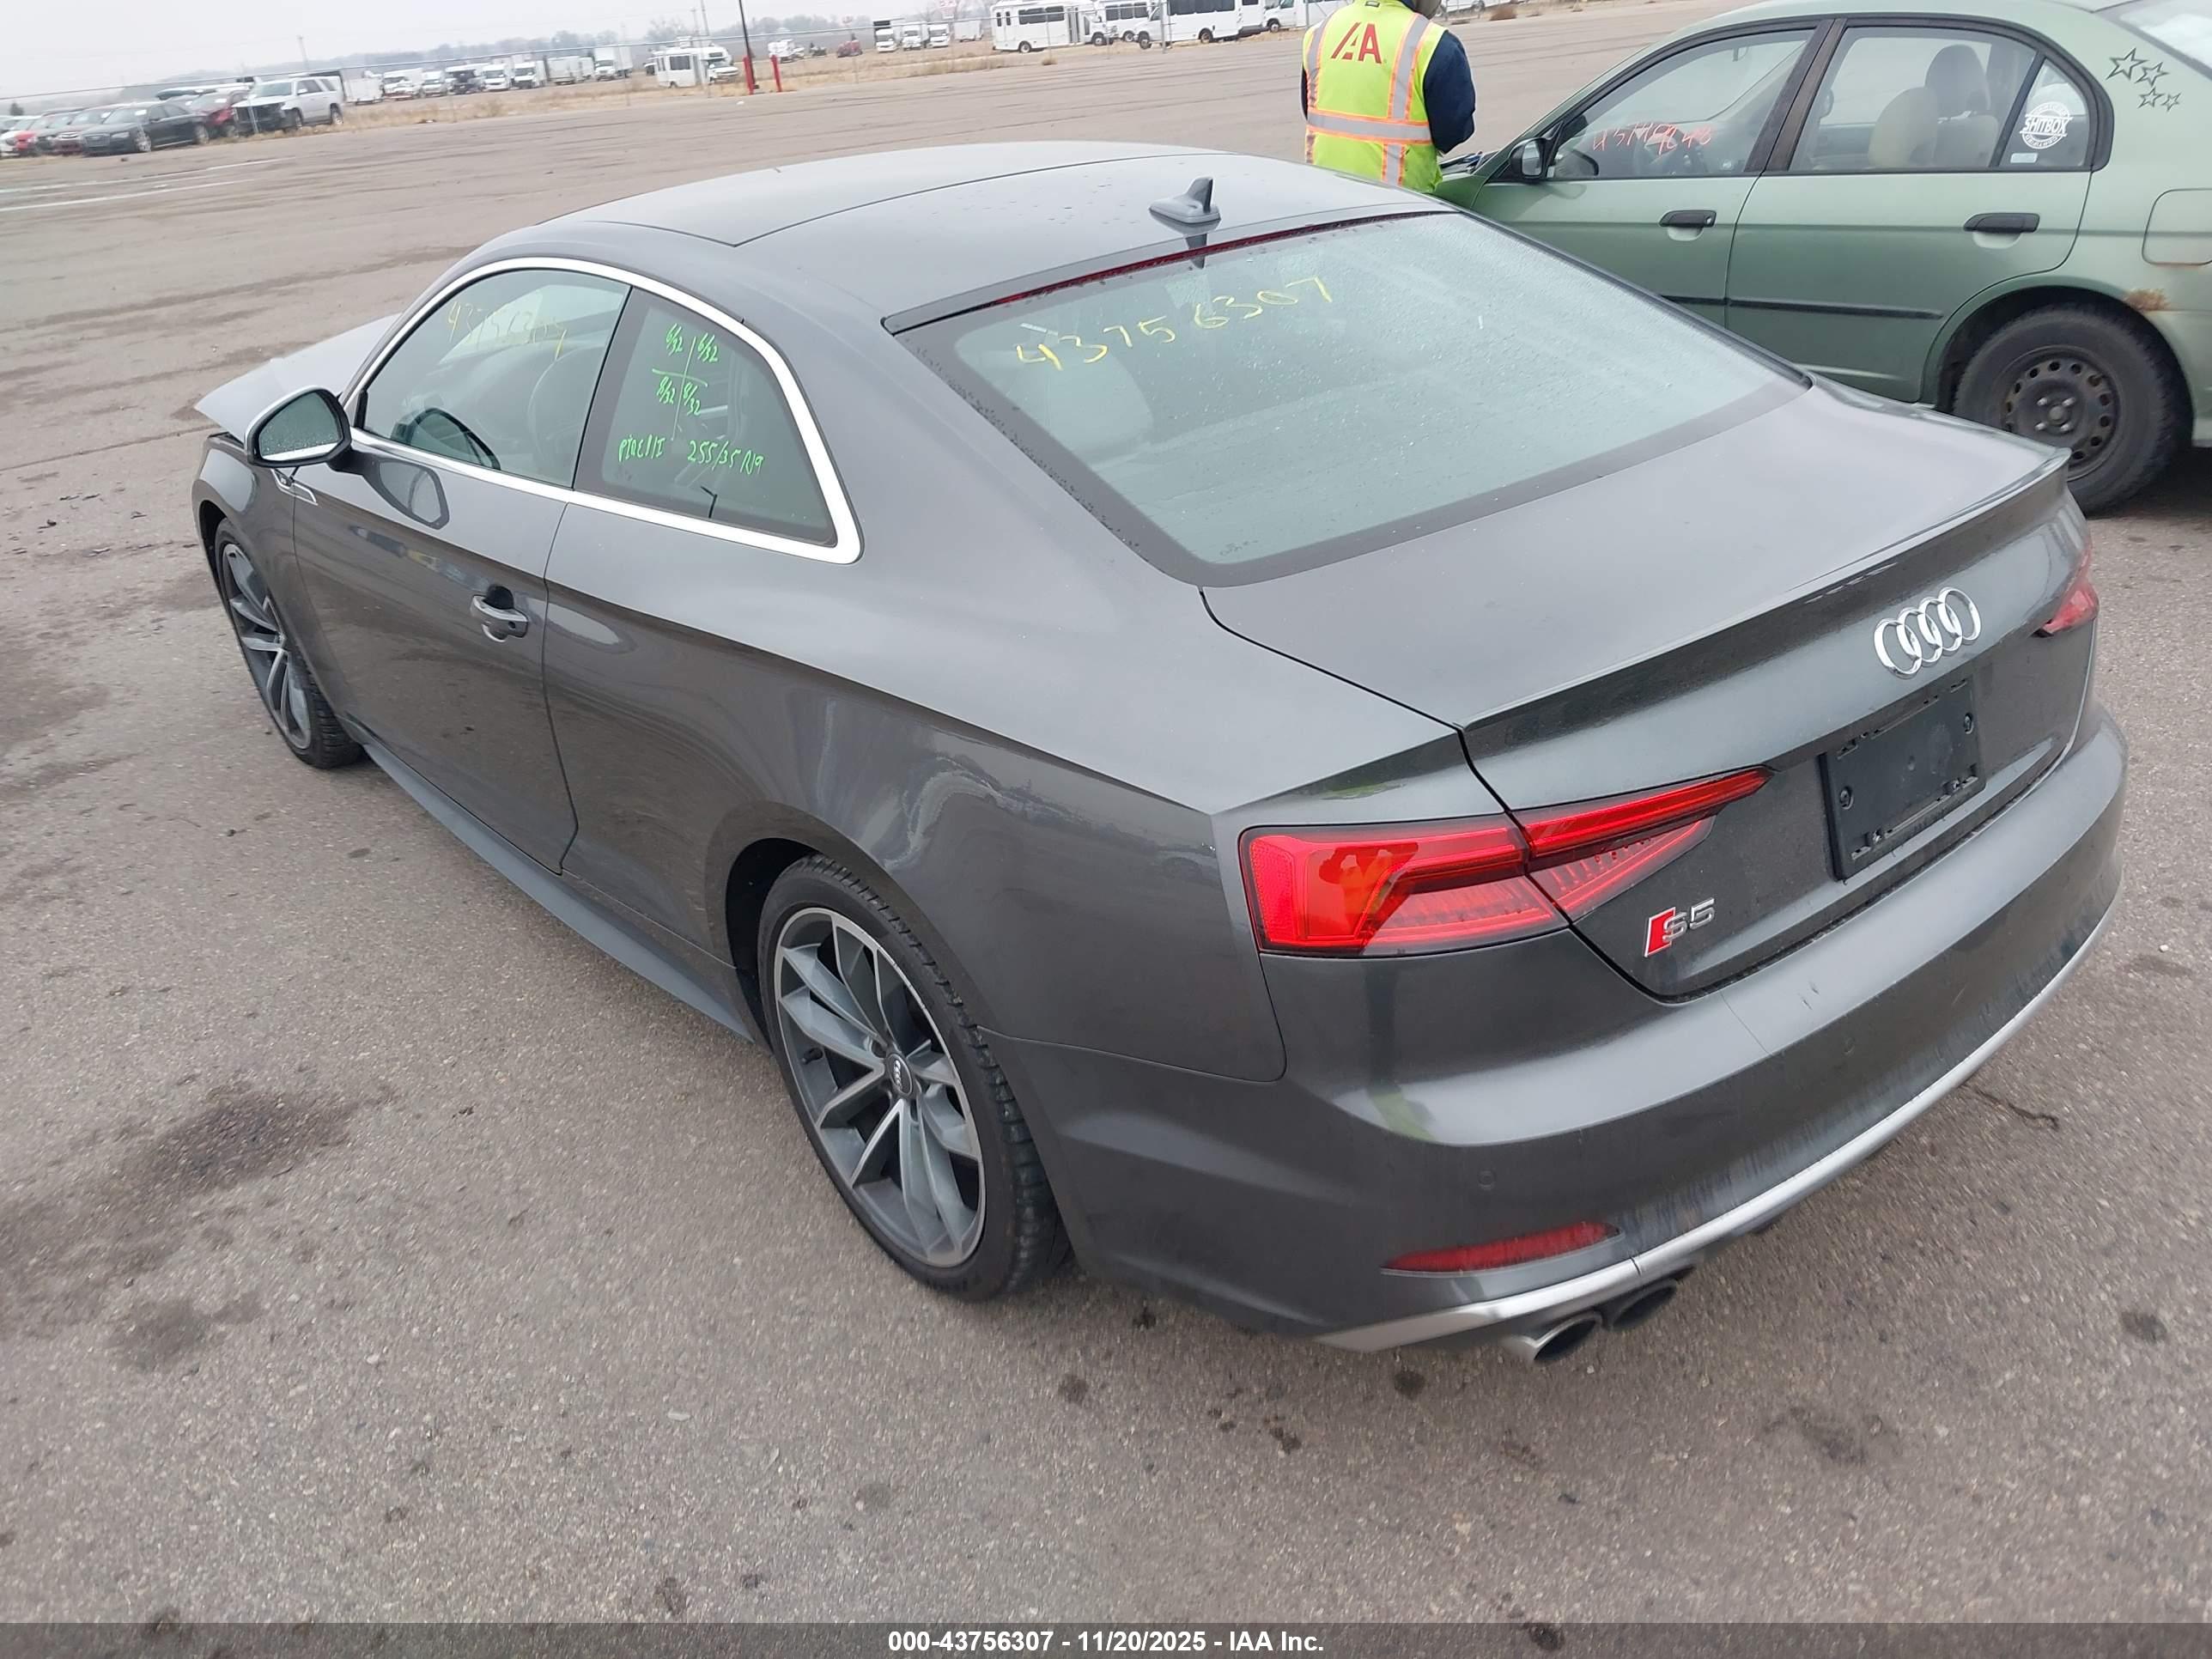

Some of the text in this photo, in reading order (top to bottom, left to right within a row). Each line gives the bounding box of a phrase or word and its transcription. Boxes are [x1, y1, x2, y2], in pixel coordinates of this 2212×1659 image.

[2023, 117, 2069, 134] SHITBOX
[1017, 276, 1333, 371] 43756307
[697, 332, 719, 363] 6/32
[1662, 897, 1716, 944] S5
